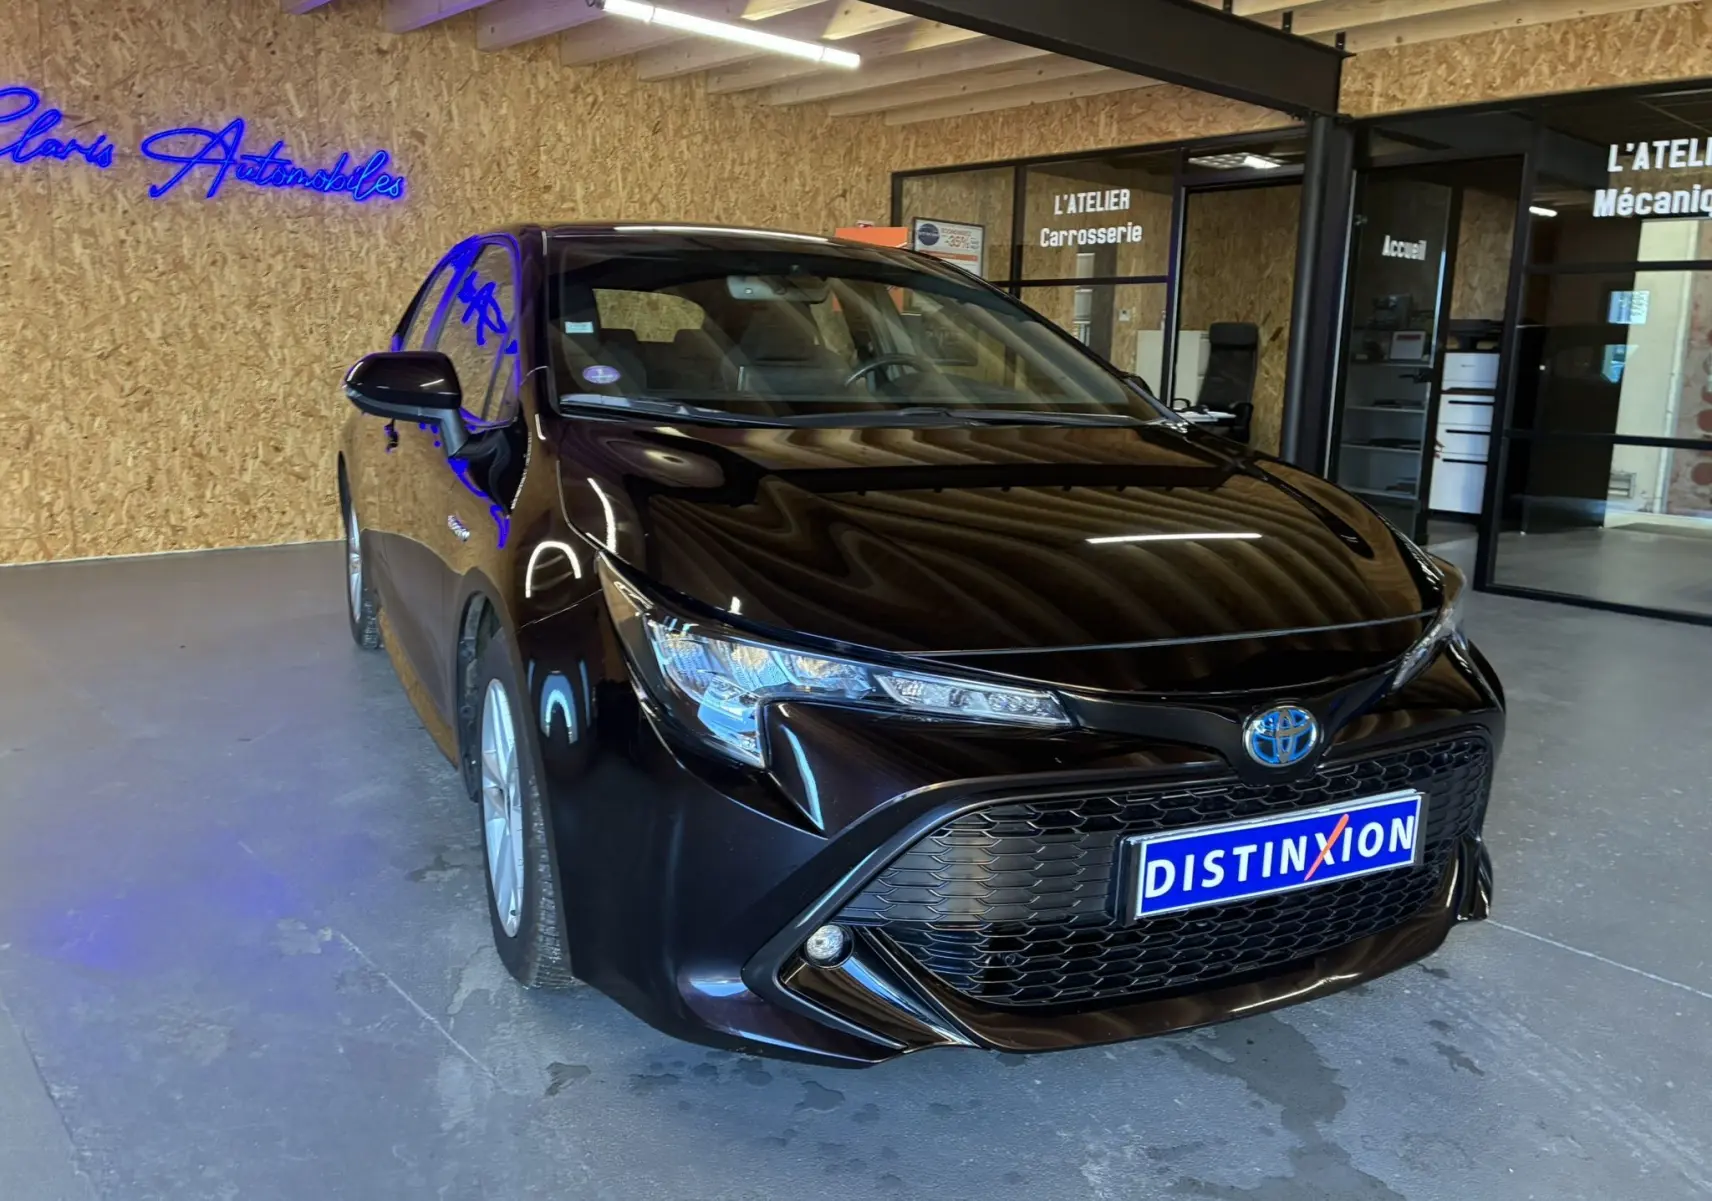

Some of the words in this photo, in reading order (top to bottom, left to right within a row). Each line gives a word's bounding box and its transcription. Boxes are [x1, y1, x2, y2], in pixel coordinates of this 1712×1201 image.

[141, 118, 404, 201] Automobiles
[1054, 188, 1131, 215] L'ATELIER
[1040, 221, 1143, 247] Carrosserie
[1382, 235, 1427, 260] Accueil
[1145, 814, 1415, 898] DISTINXION
